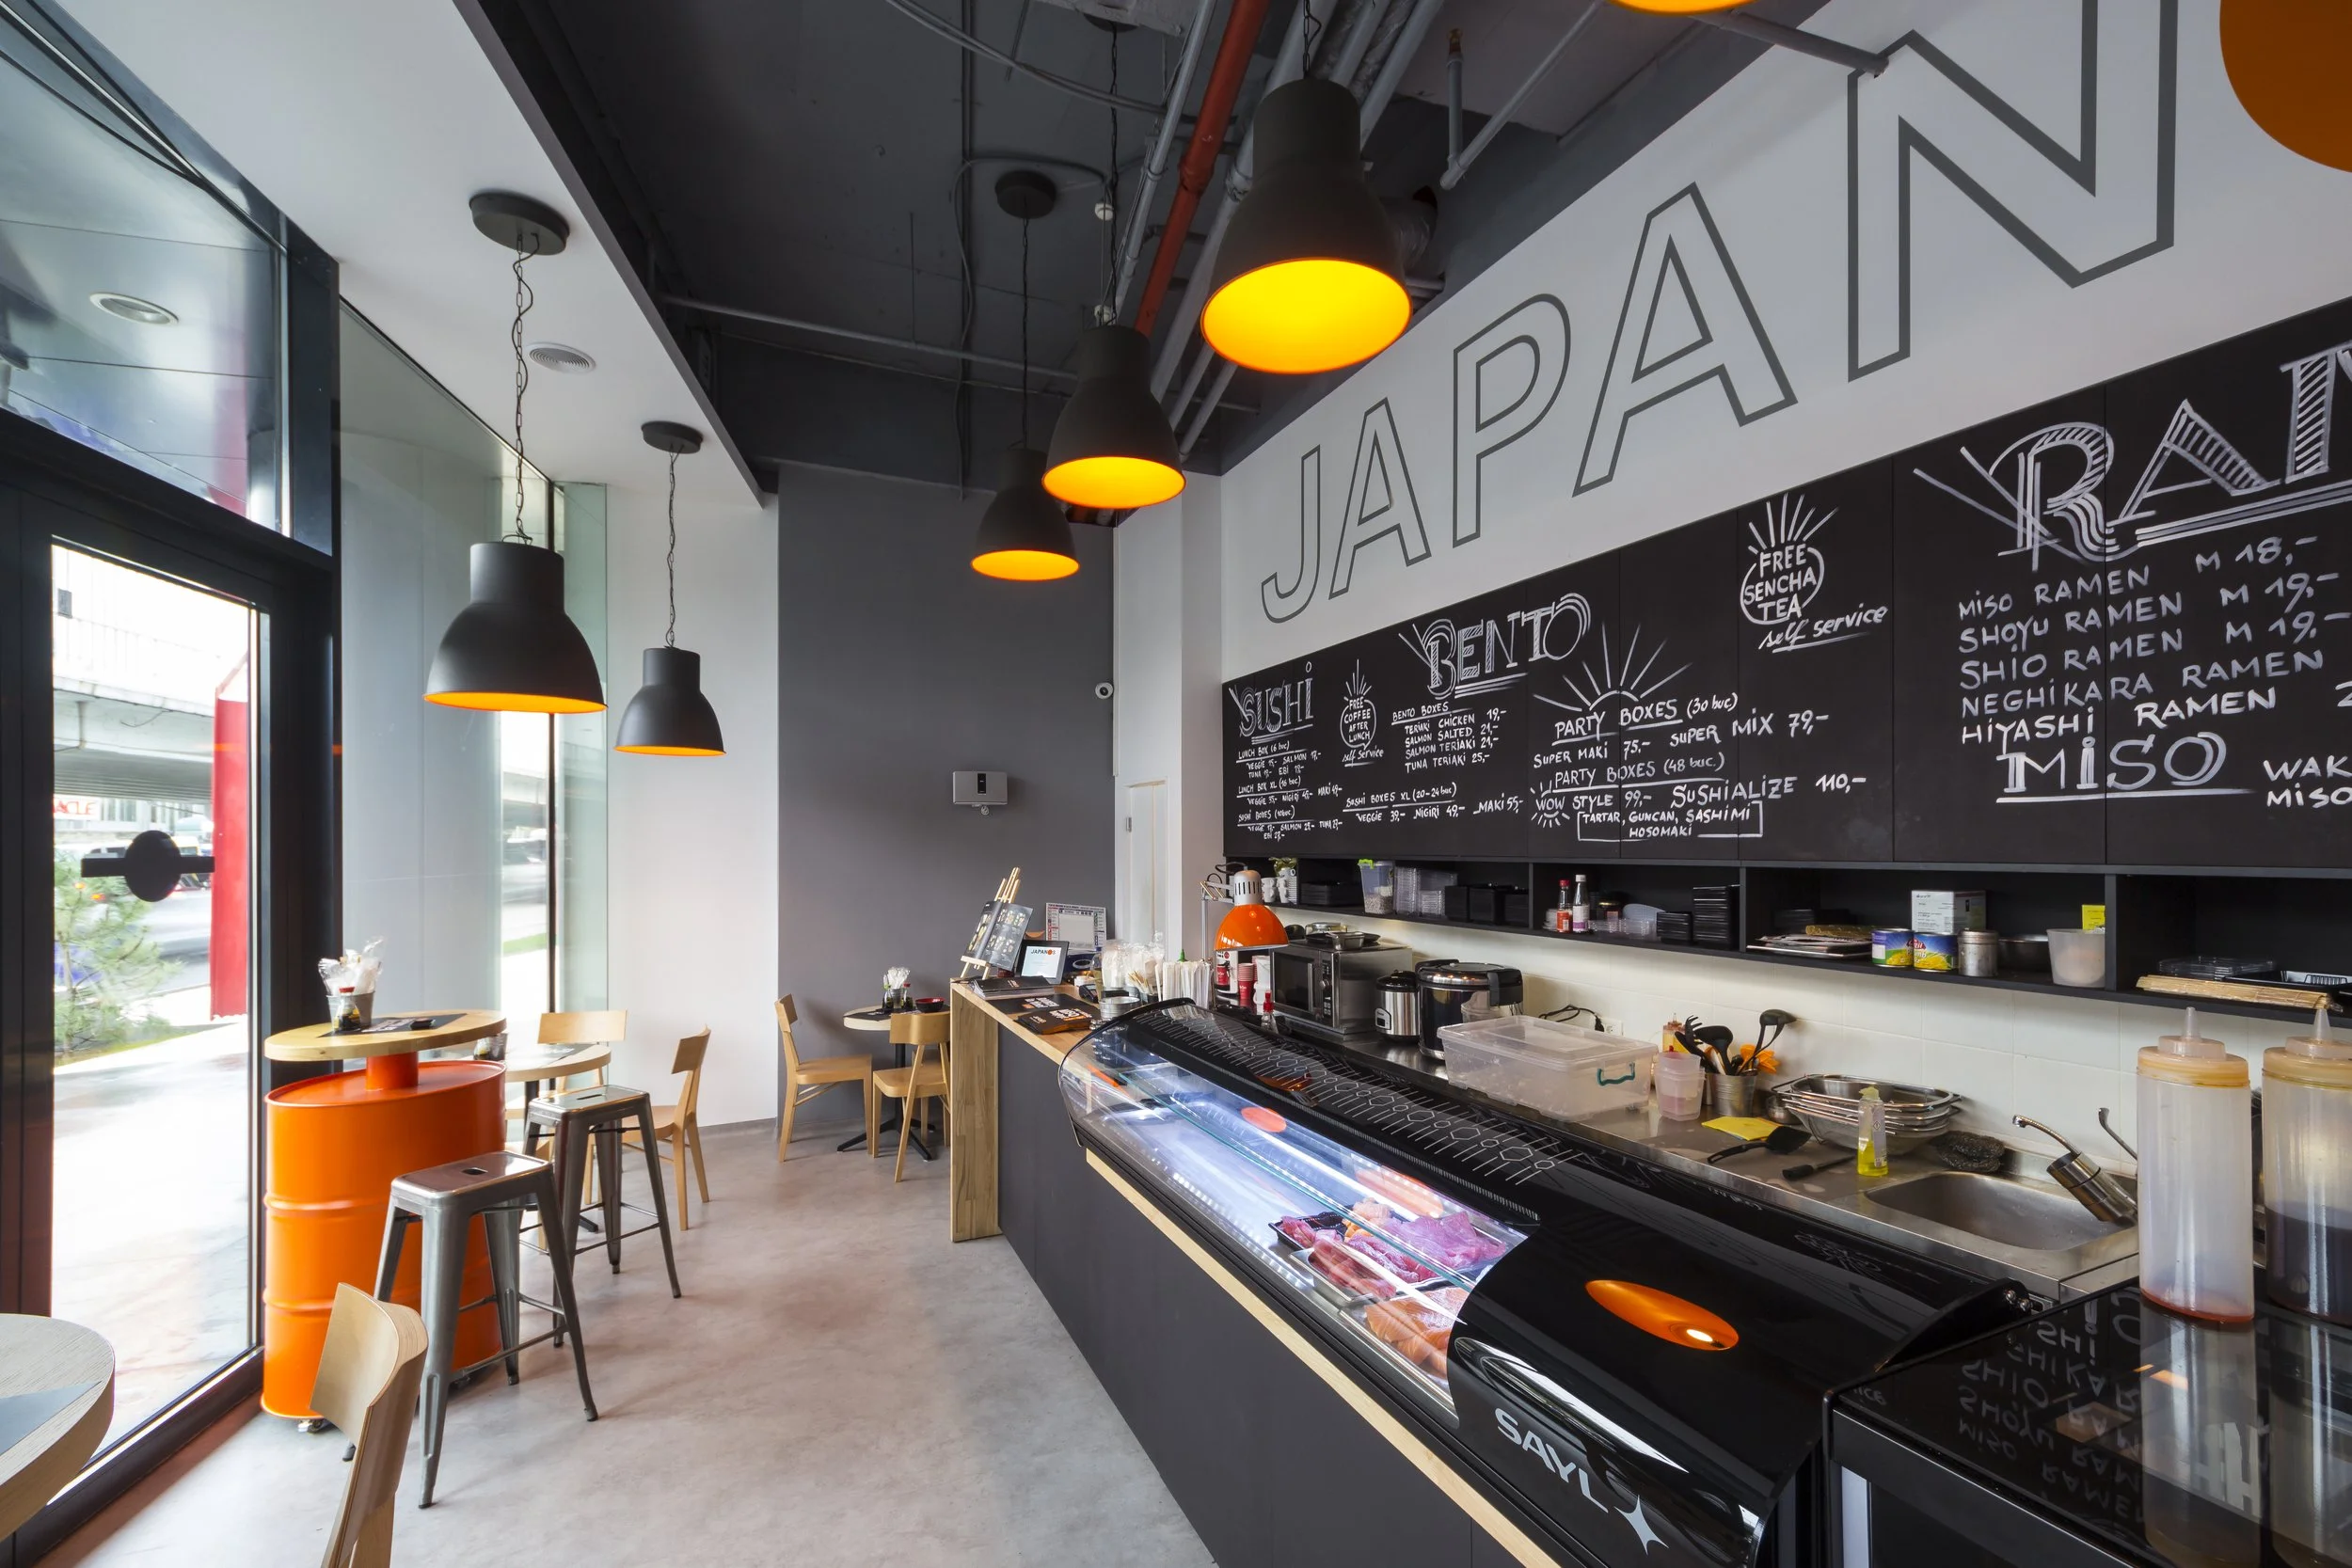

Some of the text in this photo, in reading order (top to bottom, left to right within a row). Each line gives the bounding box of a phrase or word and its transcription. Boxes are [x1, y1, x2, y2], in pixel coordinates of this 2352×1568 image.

[1262, 0, 2178, 625] JAPAN
[1759, 543, 1807, 578] FREE
[1742, 566, 1818, 605] SENCHA
[2034, 564, 2150, 606] RAMEN
[2195, 550, 2221, 574] M
[1756, 593, 1803, 622] TEA
[1757, 603, 1888, 651] self service
[1959, 615, 2049, 654] SHOYU
[2065, 592, 2183, 633] RAMEN
[2219, 583, 2249, 607] M
[1422, 594, 1591, 700] BENTO
[2064, 627, 2183, 671] RAMEN
[2226, 621, 2252, 644] M
[2182, 649, 2324, 689] RAMEN
[1349, 696, 1364, 710] FREE
[1392, 702, 1449, 721] BENTO BOXES
[2134, 687, 2277, 729] RAMEN
[1343, 708, 1371, 723] COFFEE
[1554, 710, 1606, 741] PARTY
[1619, 699, 1677, 726] BOXES
[1349, 721, 1368, 733] AFTER
[1349, 731, 1371, 742] LUNCH
[1405, 733, 1432, 748] SALMON
[1438, 727, 1472, 741] SALTED
[1238, 749, 1255, 760] LUNCH
[1258, 746, 1268, 756] BOX
[1282, 752, 1307, 765] SALMON
[1405, 744, 1437, 759] SALMON
[1248, 770, 1262, 779] TUNA
[1405, 758, 1427, 773] TUNA
[1555, 768, 1596, 788] PARTY
[1606, 761, 1656, 783] BOXES
[1238, 784, 1254, 794] LUNCH
[1257, 783, 1267, 791] BOX
[1270, 781, 1277, 789] XL
[1371, 792, 1396, 803] BOXES
[1401, 792, 1411, 800] XL
[1535, 796, 1565, 811] WOW
[1572, 794, 1613, 813] STYLE
[1255, 809, 1271, 820] BOXES
[1319, 820, 1331, 830] TUNA
